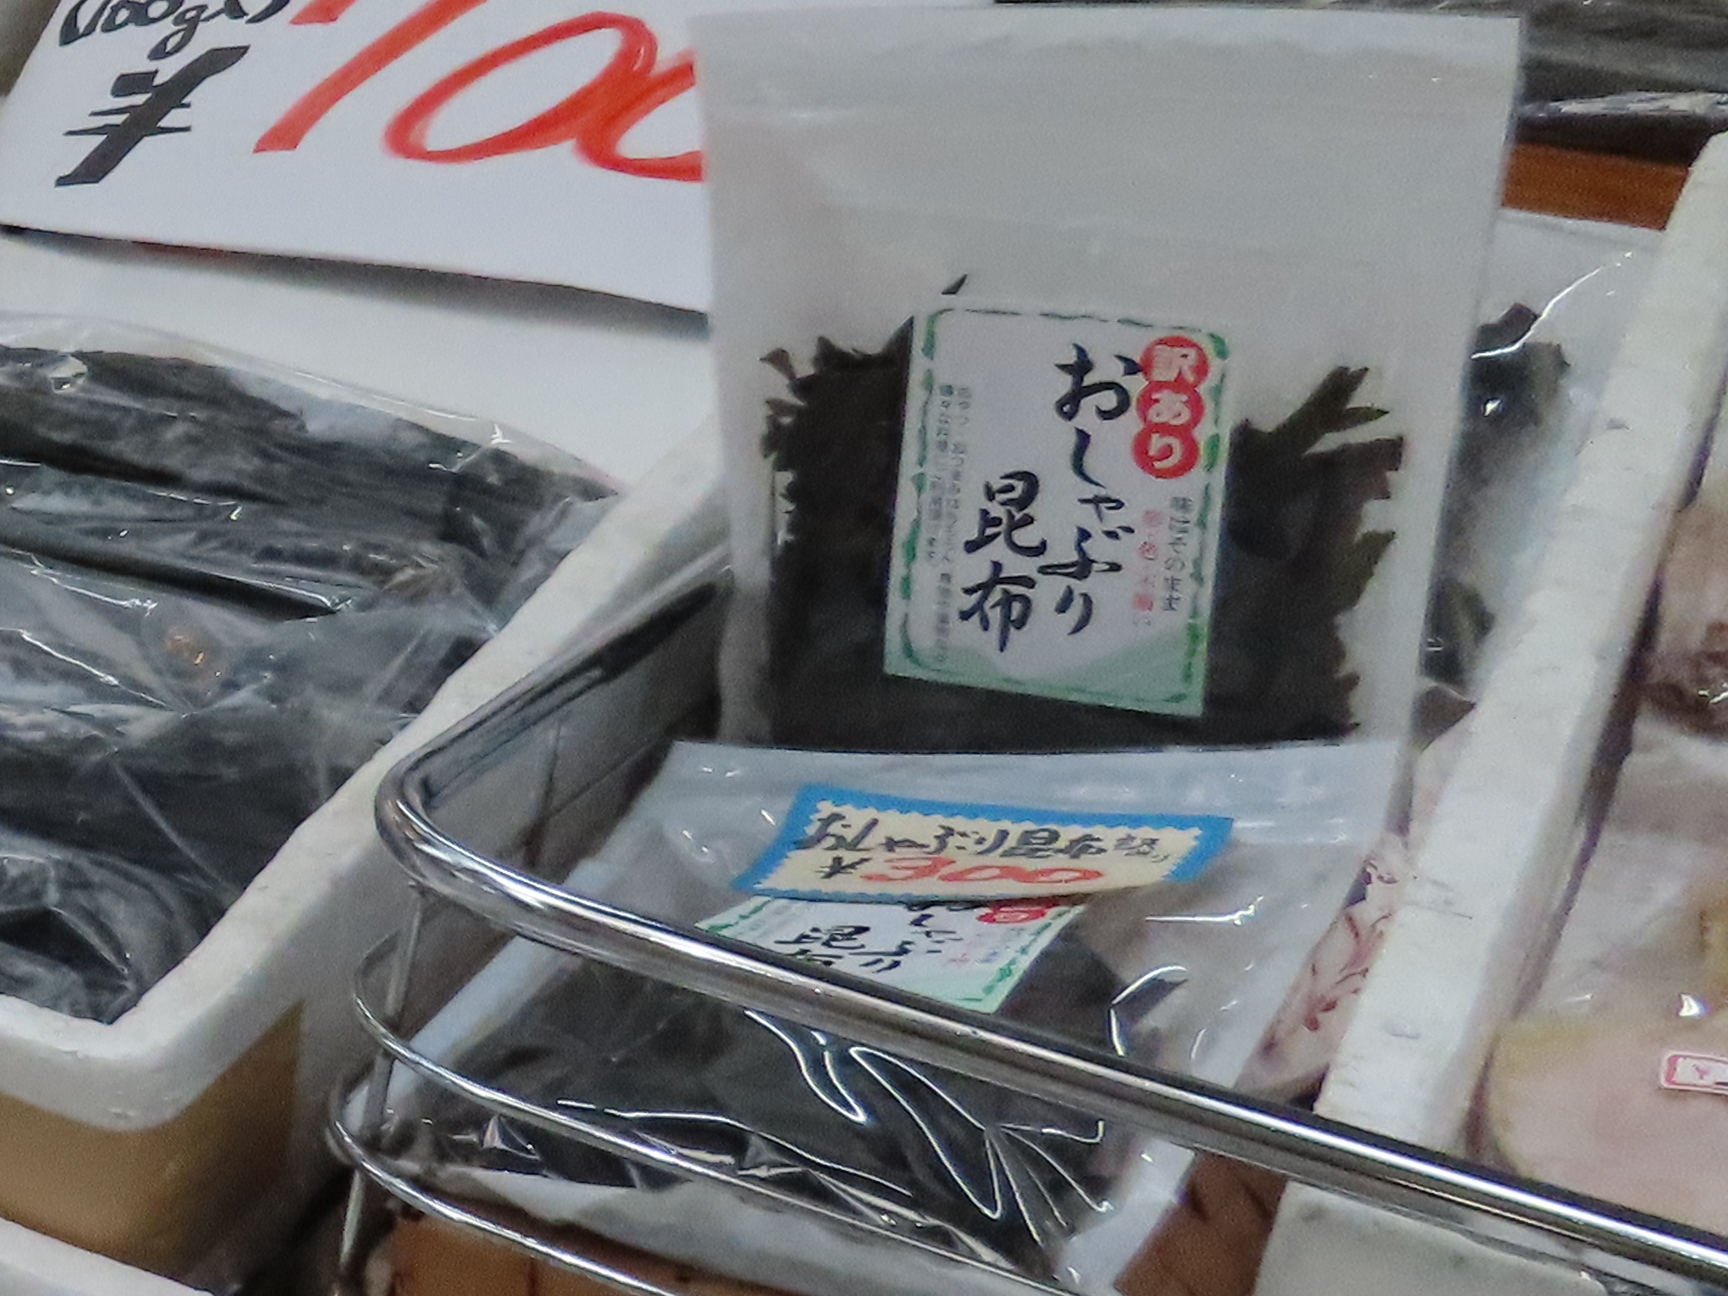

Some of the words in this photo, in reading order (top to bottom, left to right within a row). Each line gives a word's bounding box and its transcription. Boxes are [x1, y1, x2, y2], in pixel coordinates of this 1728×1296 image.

[1140, 338, 1205, 475] 訳あり
[958, 469, 1048, 654] 昆布
[1037, 342, 1144, 636] おしゃぶり
[816, 855, 1104, 884] ¥300
